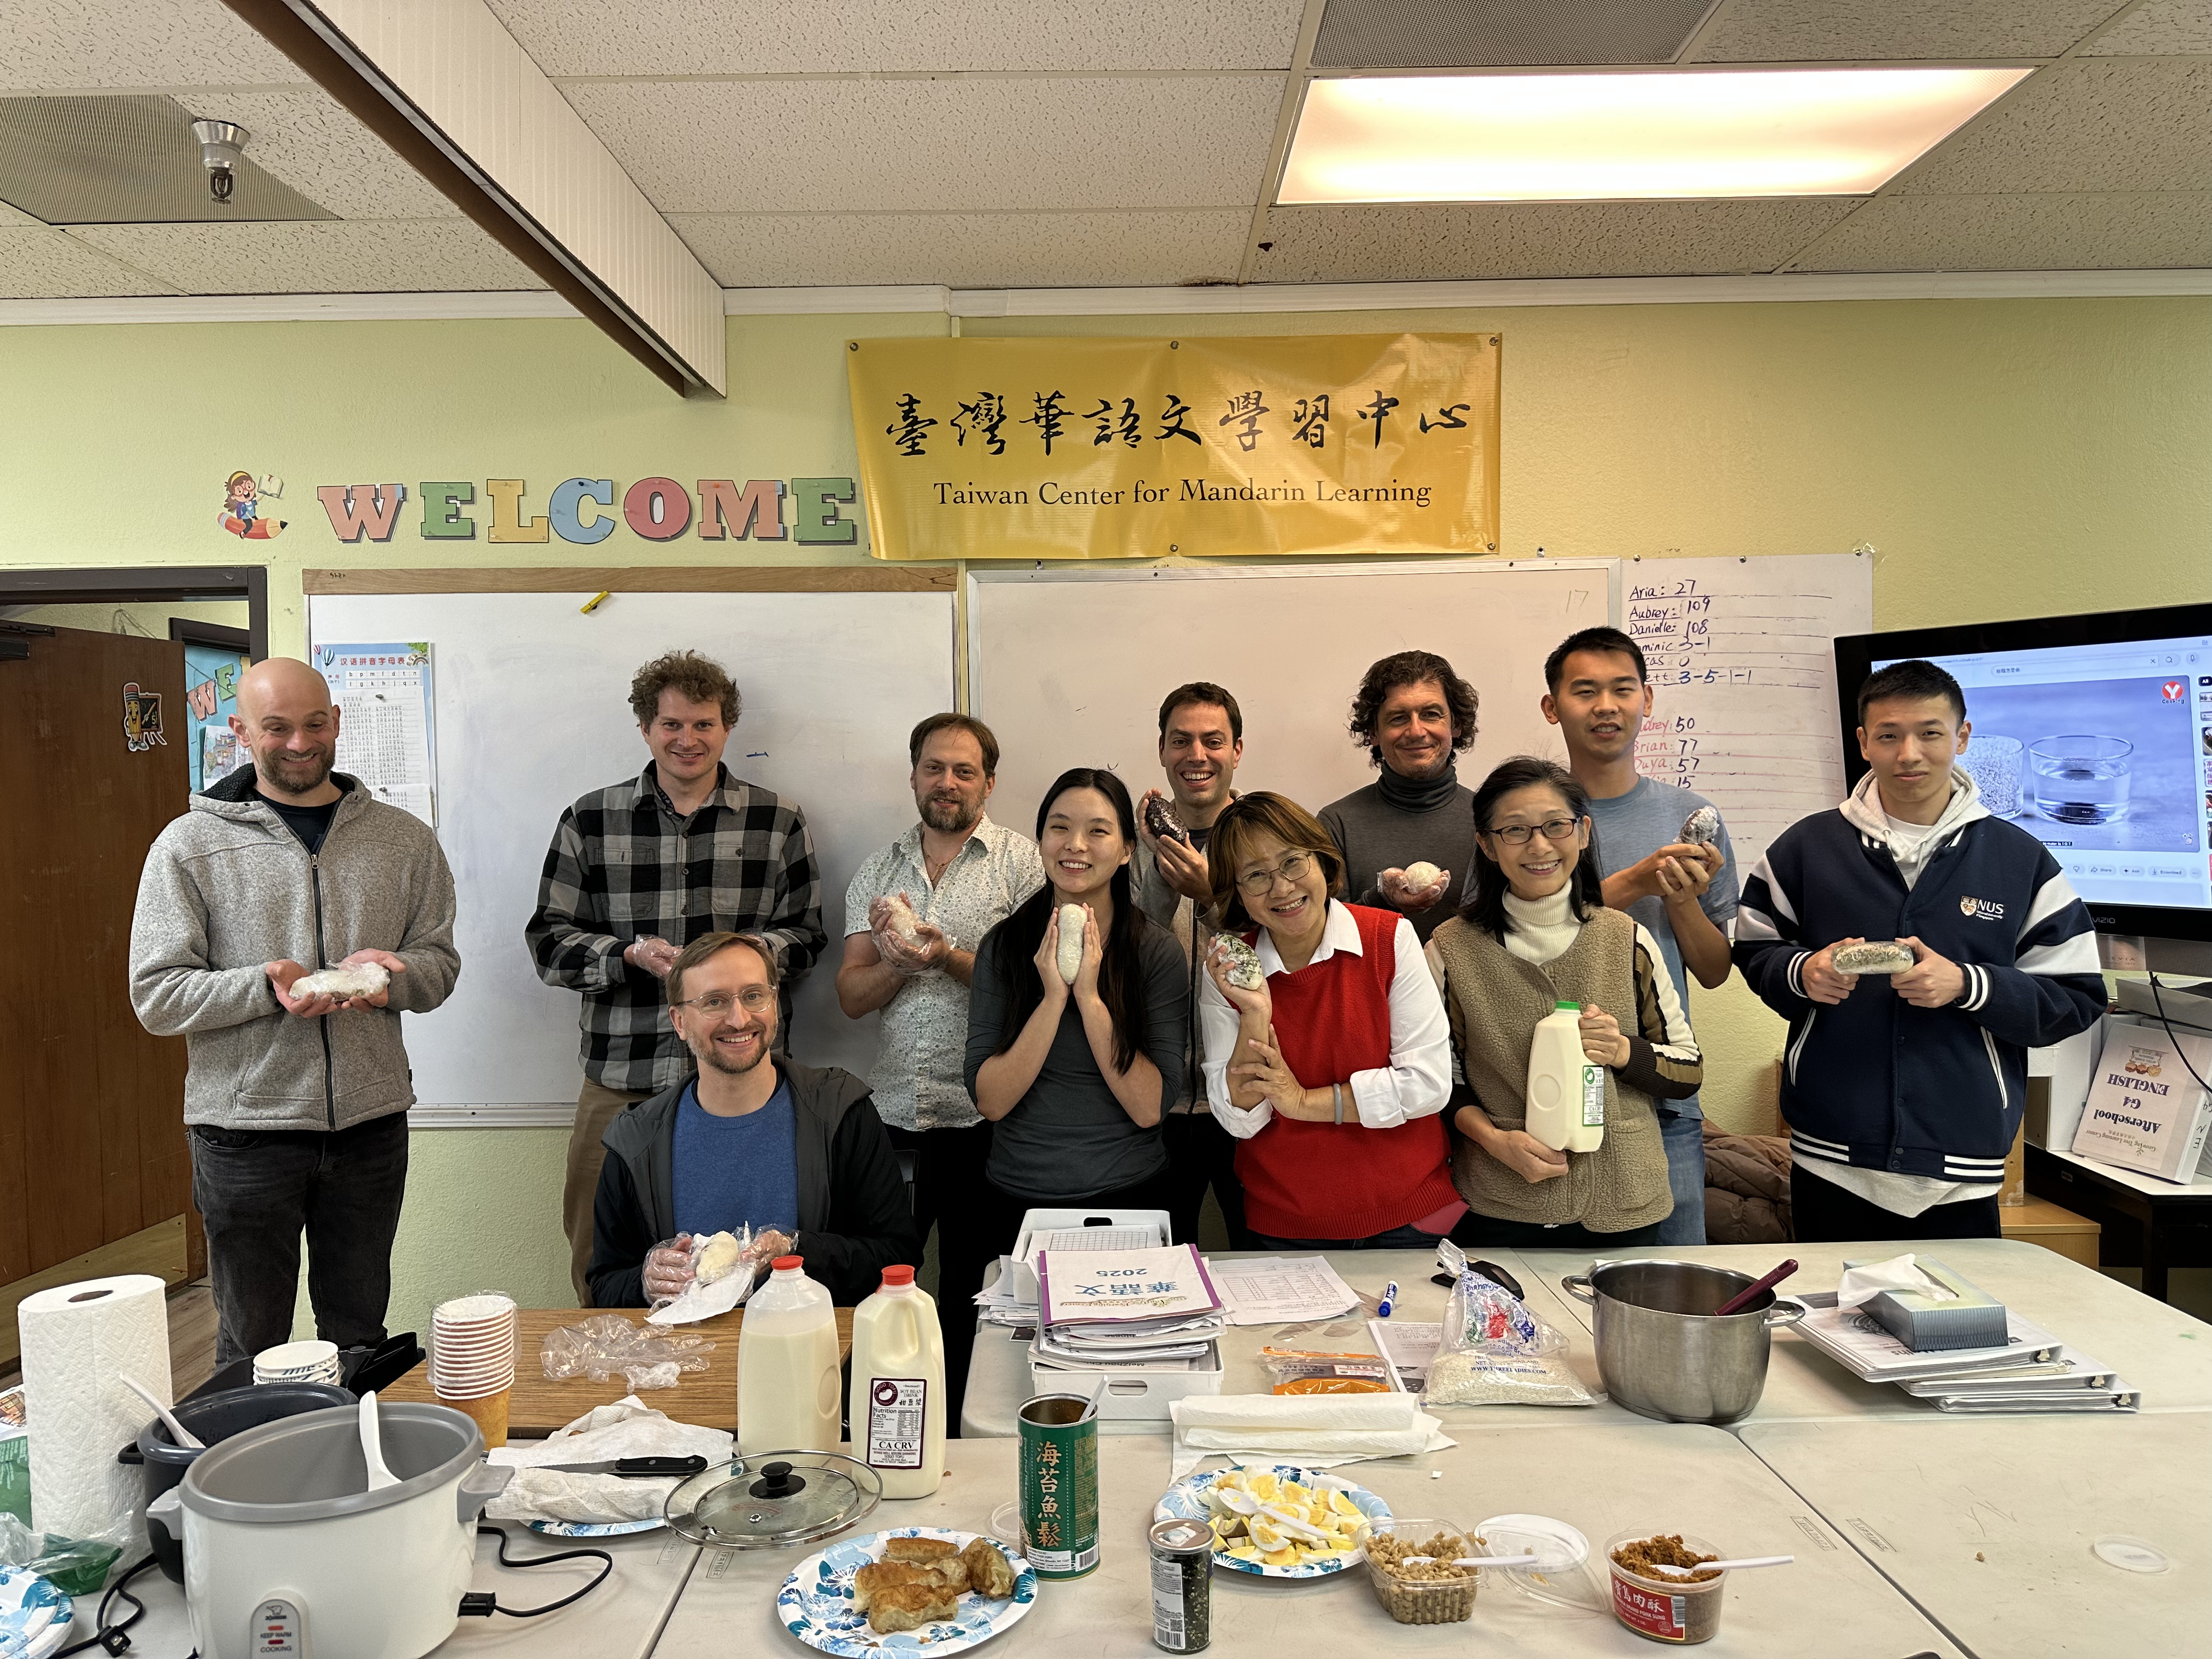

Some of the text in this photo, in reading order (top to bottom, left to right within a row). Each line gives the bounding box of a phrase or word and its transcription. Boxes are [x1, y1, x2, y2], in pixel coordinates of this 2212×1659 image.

[885, 390, 1468, 457] 臺灣華語文學習中心
[934, 478, 1432, 508] Taiwan Center for Mandarin Learning
[317, 477, 855, 544] WELCOME
[1674, 579, 1696, 596] 27
[1686, 597, 1711, 615] 109
[1685, 619, 1708, 637] 108
[340, 657, 405, 666] 汉语拼音字母表
[1675, 716, 1695, 733] 50
[1678, 738, 1698, 755] 77
[1675, 756, 1700, 773] 57
[1677, 775, 1696, 789] 15
[1977, 899, 2004, 915] NUS
[2107, 1074, 2170, 1096] ENGLISH
[2123, 1096, 2141, 1110] G4
[2093, 1109, 2162, 1135] Afterschool
[2085, 1130, 2102, 1139] Center
[2101, 1133, 2122, 1144] Learning
[2193, 1137, 2201, 1149] E
[2123, 1139, 2133, 1149] Tree
[1096, 1268, 1148, 1277] 2025
[1075, 1281, 1178, 1296] 華語文
[879, 1441, 892, 1449] CA
[1036, 1441, 1063, 1547] 海苔魚鬆
